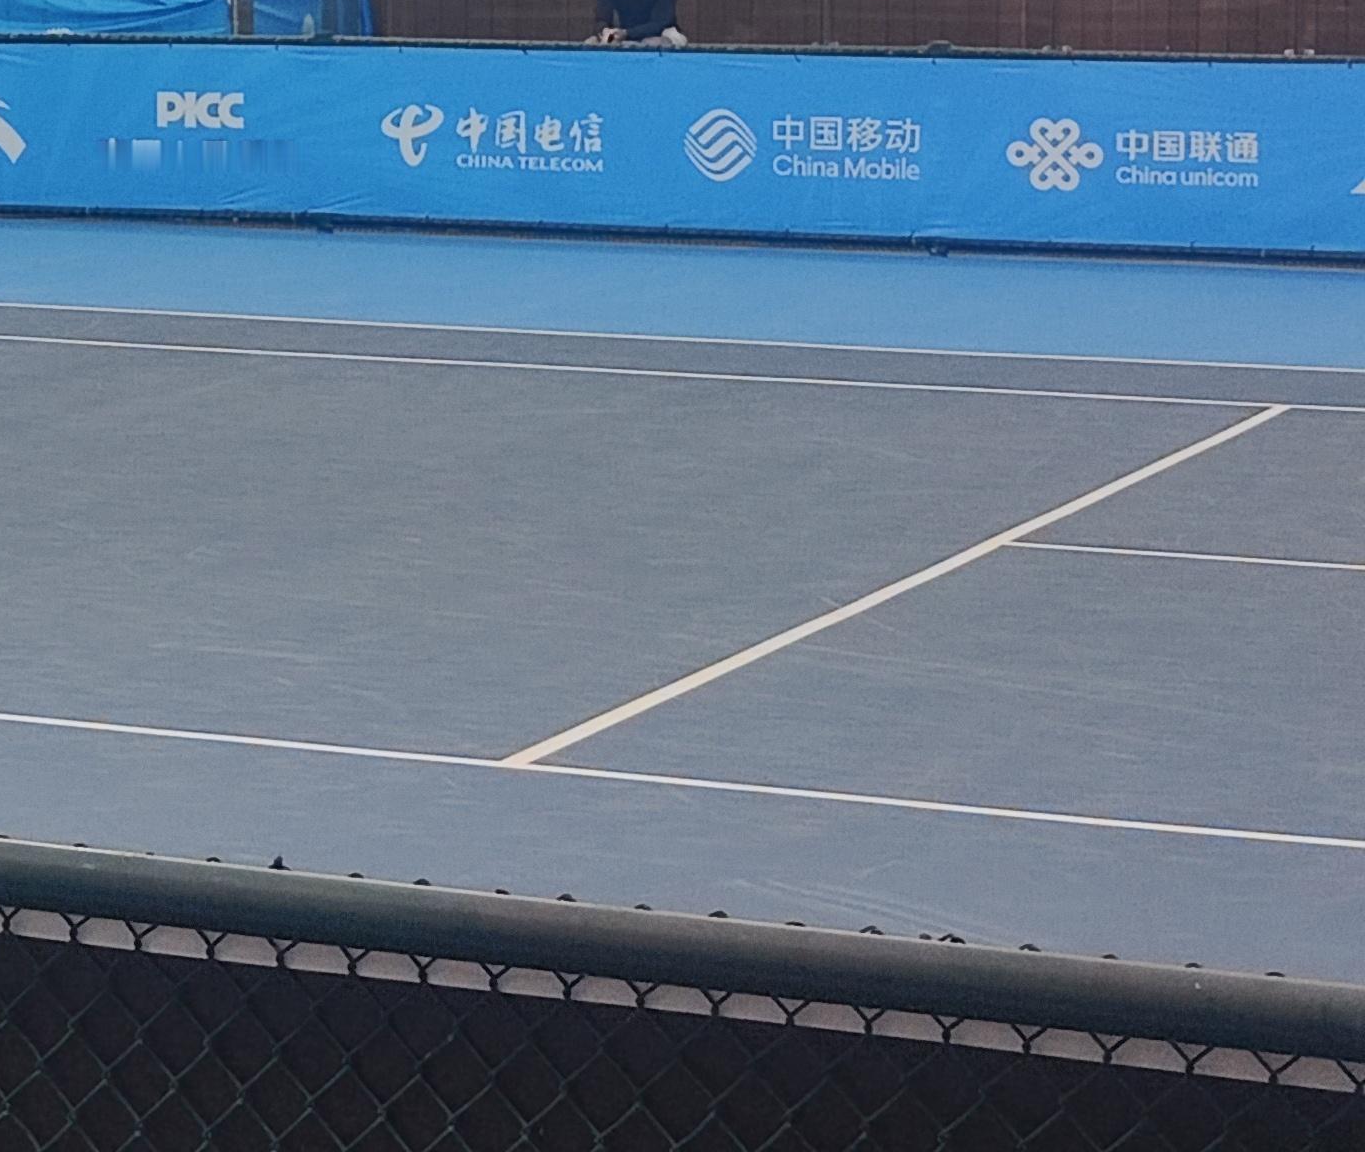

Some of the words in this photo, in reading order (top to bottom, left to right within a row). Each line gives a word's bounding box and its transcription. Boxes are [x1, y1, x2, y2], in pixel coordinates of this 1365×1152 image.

[156, 90, 245, 129] PICC
[456, 106, 604, 155] 中国电信
[771, 113, 922, 154] 中国移动
[1115, 128, 1260, 165] 中国联通
[456, 153, 515, 170] CHINA
[518, 155, 604, 173] TELECOM
[772, 154, 840, 179] China
[843, 156, 921, 181] Mobile
[1115, 165, 1177, 187] China
[1179, 166, 1260, 188] unicom
